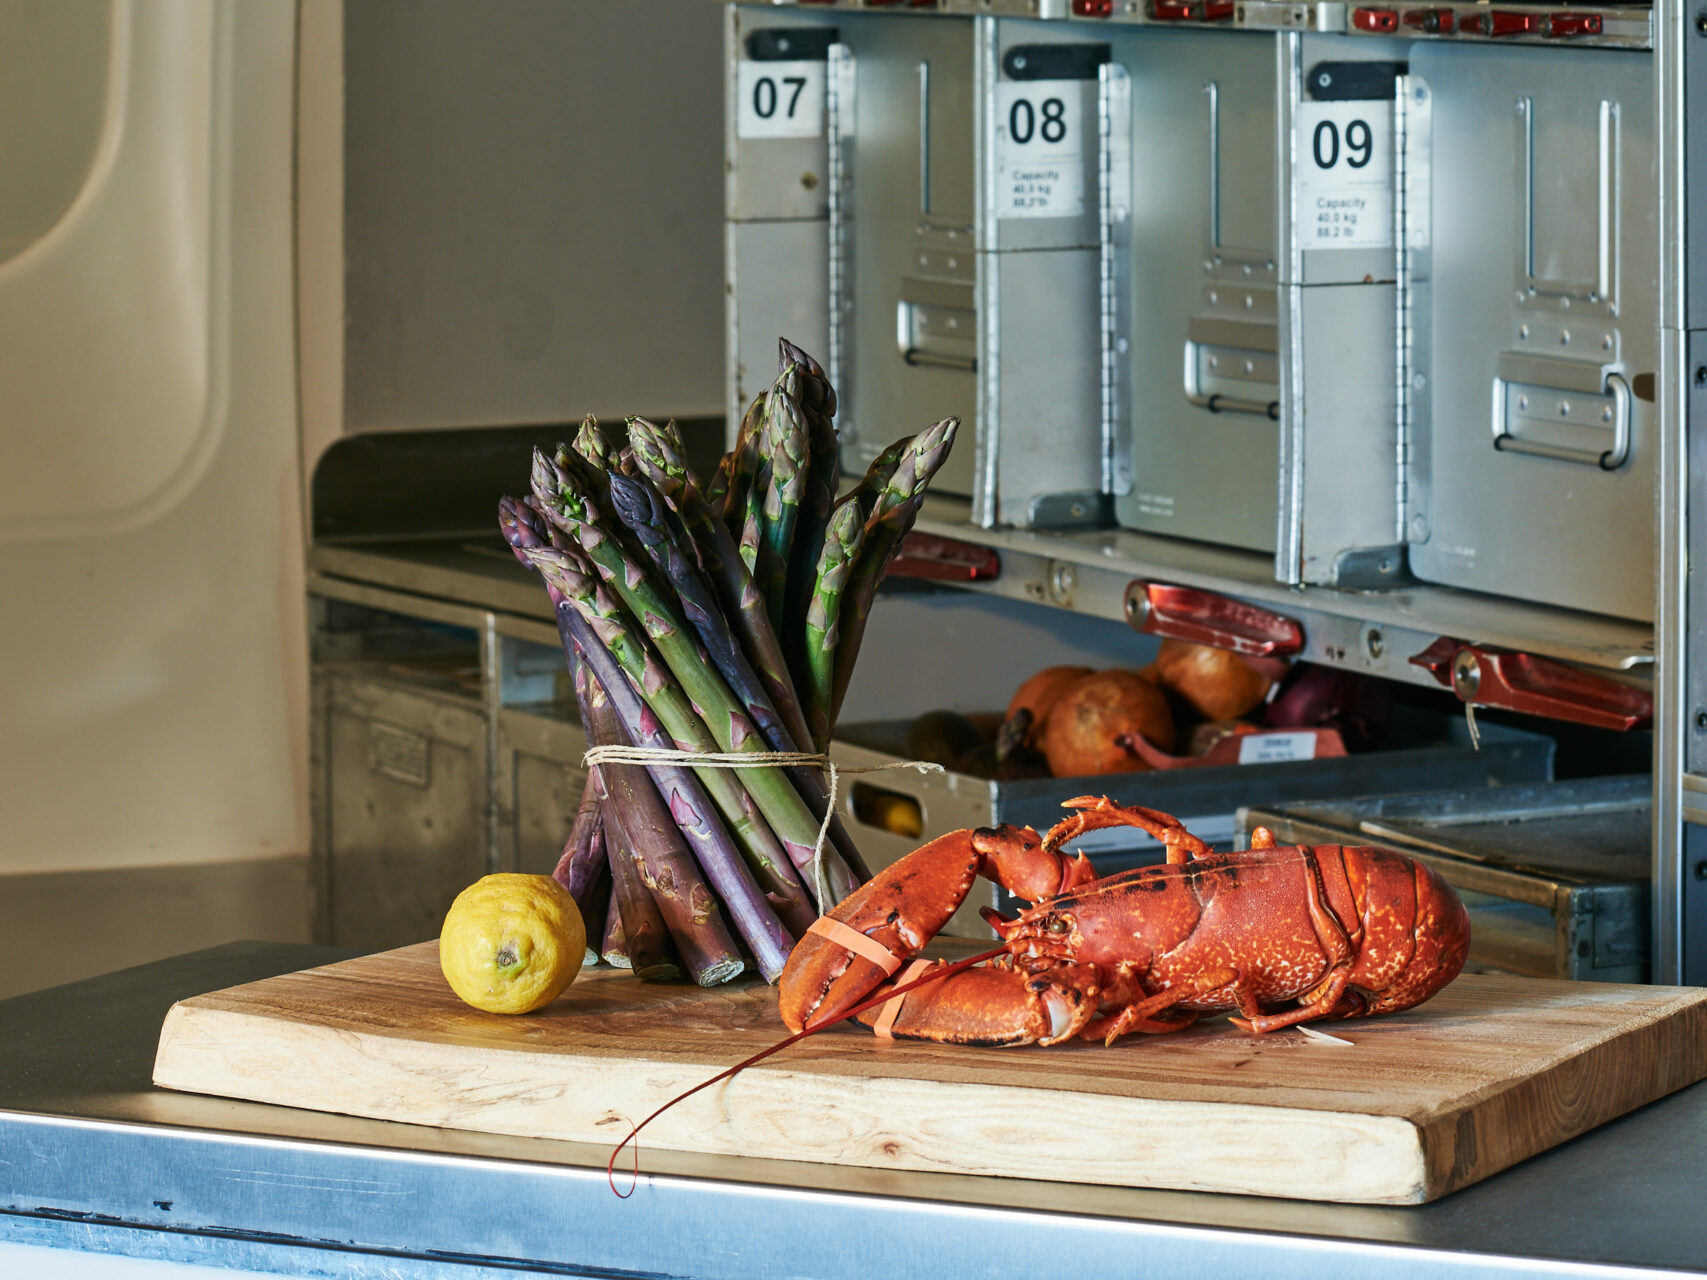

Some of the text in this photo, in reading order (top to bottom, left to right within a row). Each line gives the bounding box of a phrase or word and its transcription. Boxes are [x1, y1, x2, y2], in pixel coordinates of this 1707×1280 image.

[753, 77, 807, 118] 07
[1009, 98, 1067, 144] 08
[1313, 119, 1373, 169] 09
[1013, 170, 1059, 182] Capacity
[1317, 198, 1366, 211] Capacity
[1343, 213, 1357, 226] kg
[1343, 226, 1354, 237] lb
